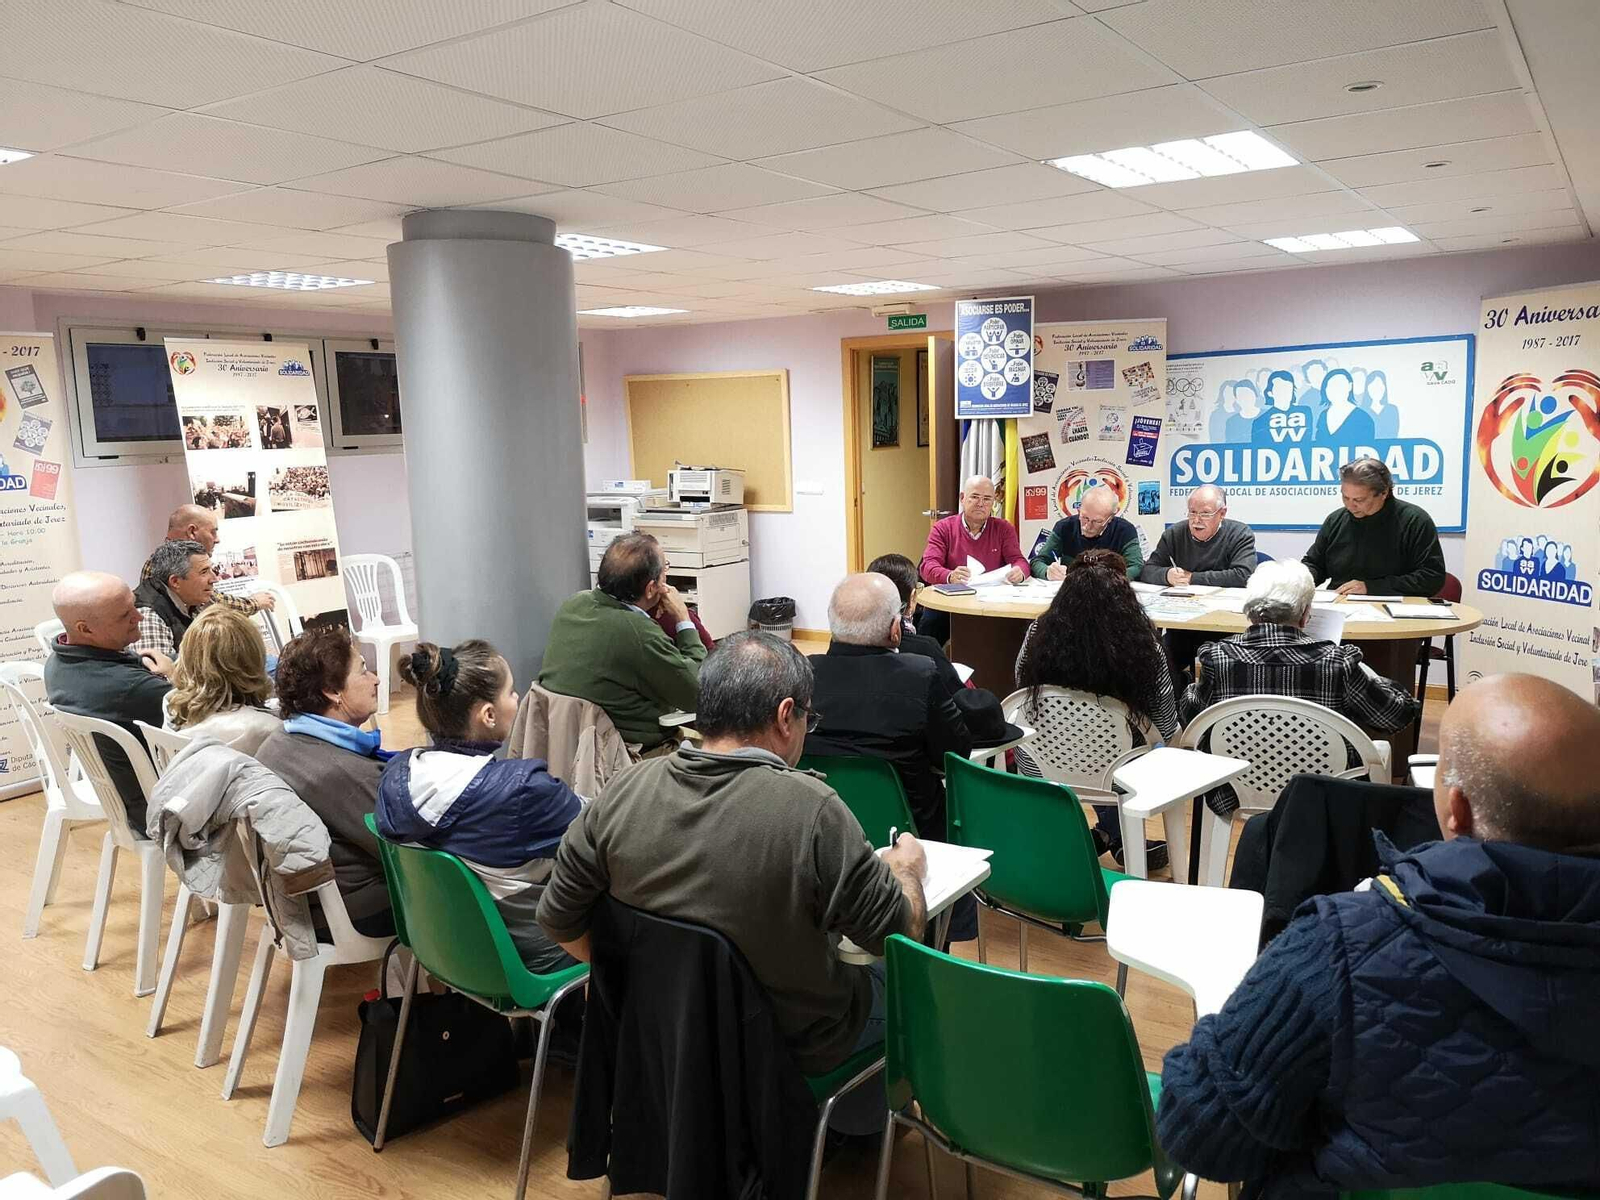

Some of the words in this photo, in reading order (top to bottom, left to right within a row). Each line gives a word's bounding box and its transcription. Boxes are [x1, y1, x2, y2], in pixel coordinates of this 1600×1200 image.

[995, 304, 1003, 314] ES
[892, 317, 924, 327] SALIDA
[1484, 308, 1508, 329] 30
[1076, 343, 1118, 351] Aniversario
[1522, 337, 1546, 350] 1987
[1556, 334, 1582, 347] 2017
[11, 346, 40, 357] 2017
[1269, 412, 1306, 428] aa
[1269, 428, 1306, 442] vv
[1036, 487, 1046, 496] 99
[1255, 487, 1266, 495] DE
[1270, 487, 1338, 496] ASOCIACIONES
[1397, 487, 1409, 495] DE
[1413, 486, 1443, 495] JEREZ
[45, 515, 65, 524] Jerez
[1481, 571, 1592, 604] SOLIDARIDAD
[1501, 617, 1517, 632] Local
[1518, 622, 1526, 632] de
[1527, 622, 1564, 640] Asociaciones
[1470, 631, 1496, 647] Inclusión
[1496, 637, 1515, 651] Social
[1517, 646, 1521, 655] y
[1523, 642, 1562, 661] Voluntariado
[1564, 651, 1572, 663] de
